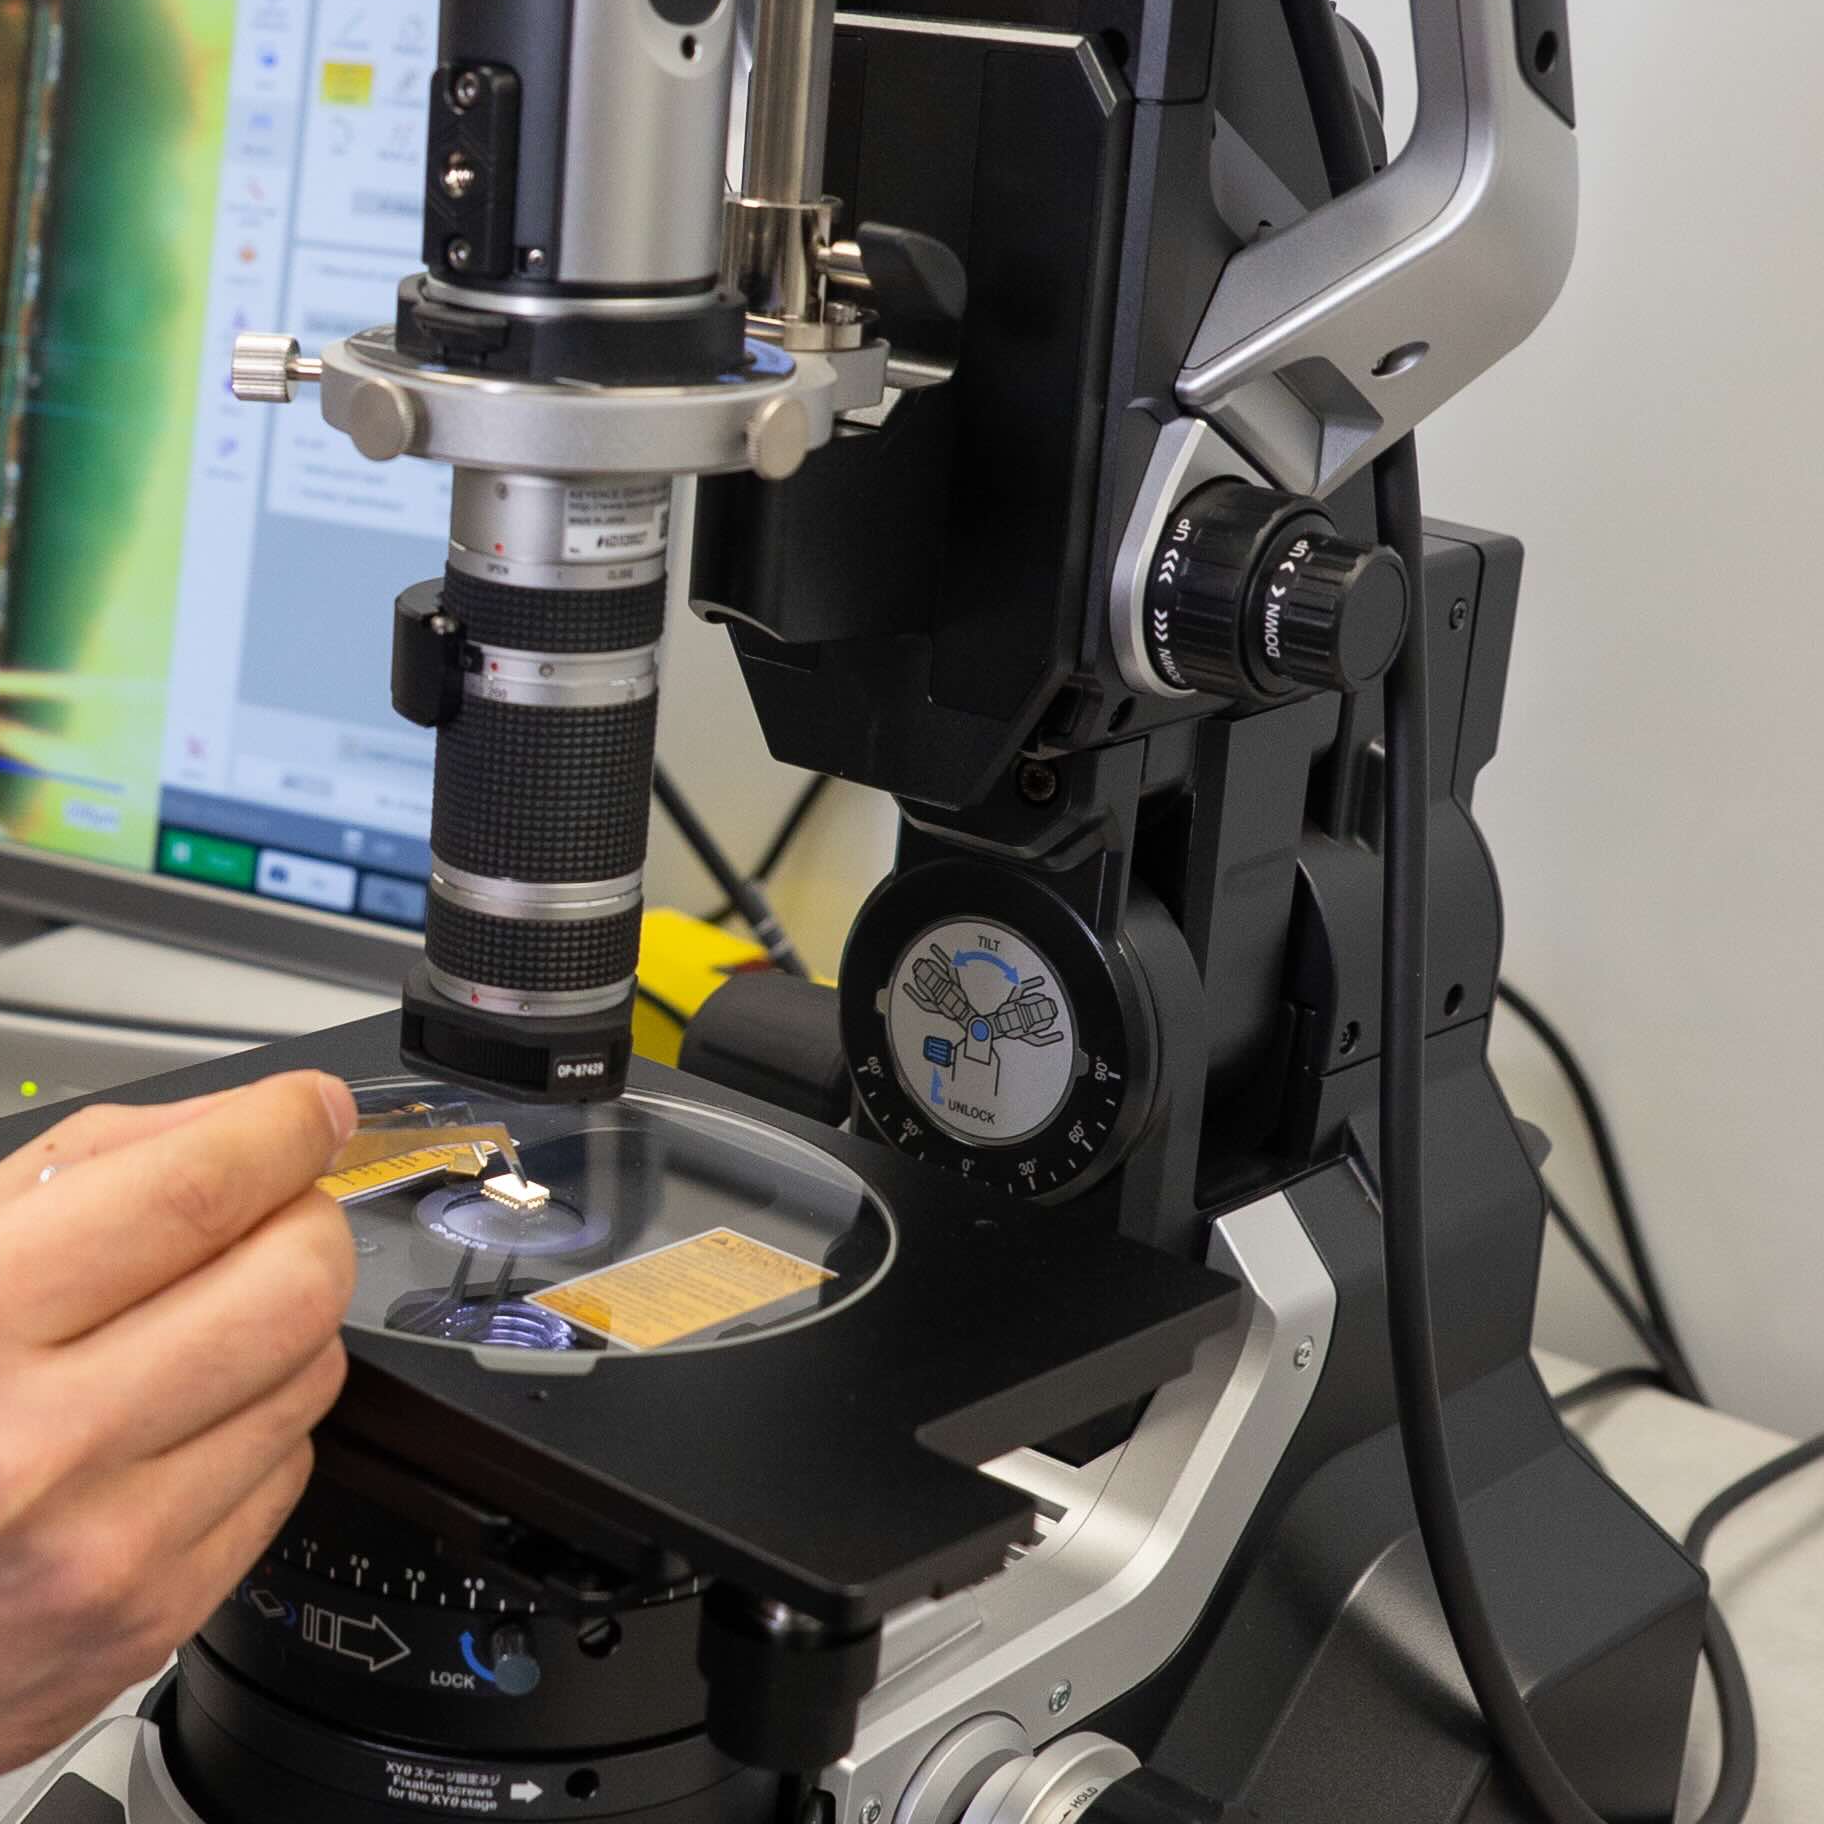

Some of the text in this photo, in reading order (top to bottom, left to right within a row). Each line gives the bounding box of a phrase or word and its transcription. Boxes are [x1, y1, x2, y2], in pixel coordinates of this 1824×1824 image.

[1173, 518, 1192, 542] UP
[1288, 539, 1310, 559] UP
[1264, 602, 1281, 659] DOWN
[976, 935, 1001, 953] TILT
[947, 1098, 997, 1125] UNLOCK
[430, 1670, 476, 1690] LOCK
[387, 1786, 405, 1799] for
[408, 1788, 429, 1803] the
[393, 1775, 494, 1799] Fixation screws
[1070, 1786, 1098, 1809] HOLD
